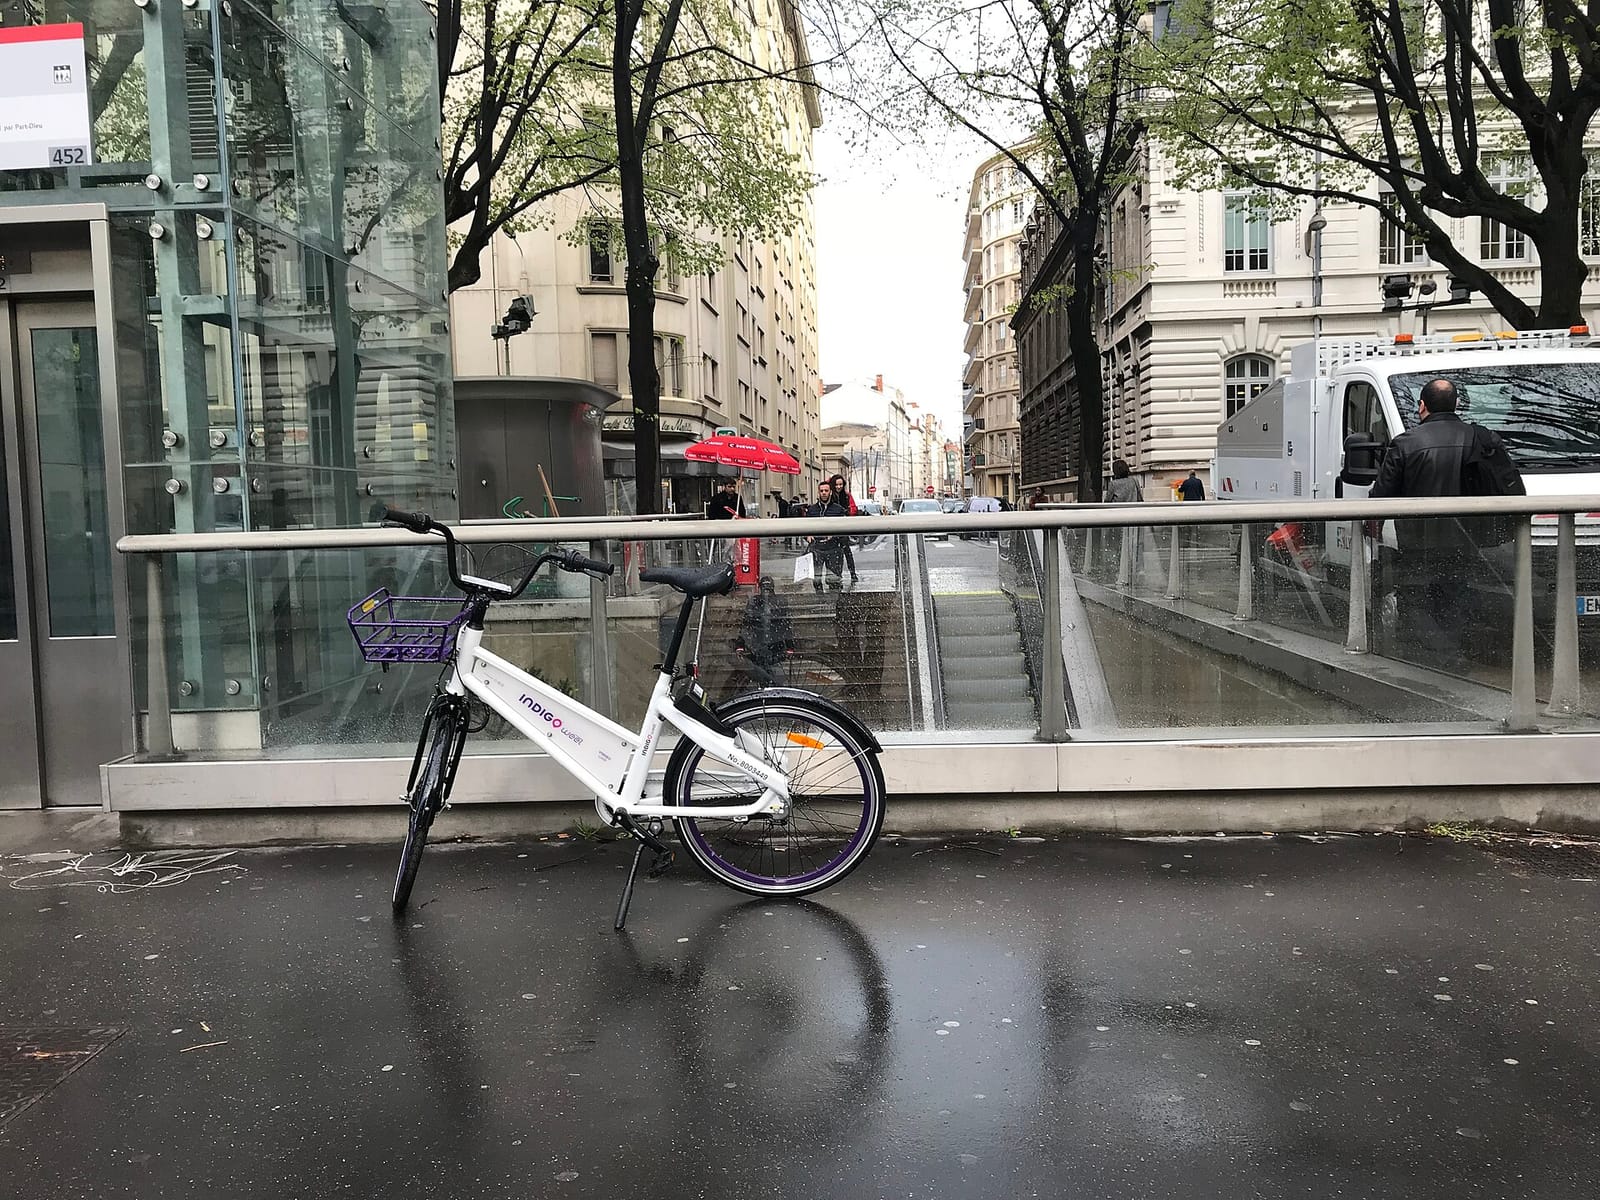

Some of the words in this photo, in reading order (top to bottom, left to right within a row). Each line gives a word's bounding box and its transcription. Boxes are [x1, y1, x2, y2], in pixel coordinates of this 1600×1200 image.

[53, 148, 84, 164] 452
[518, 693, 562, 728] INDIGO
[641, 735, 653, 756] INDIGO
